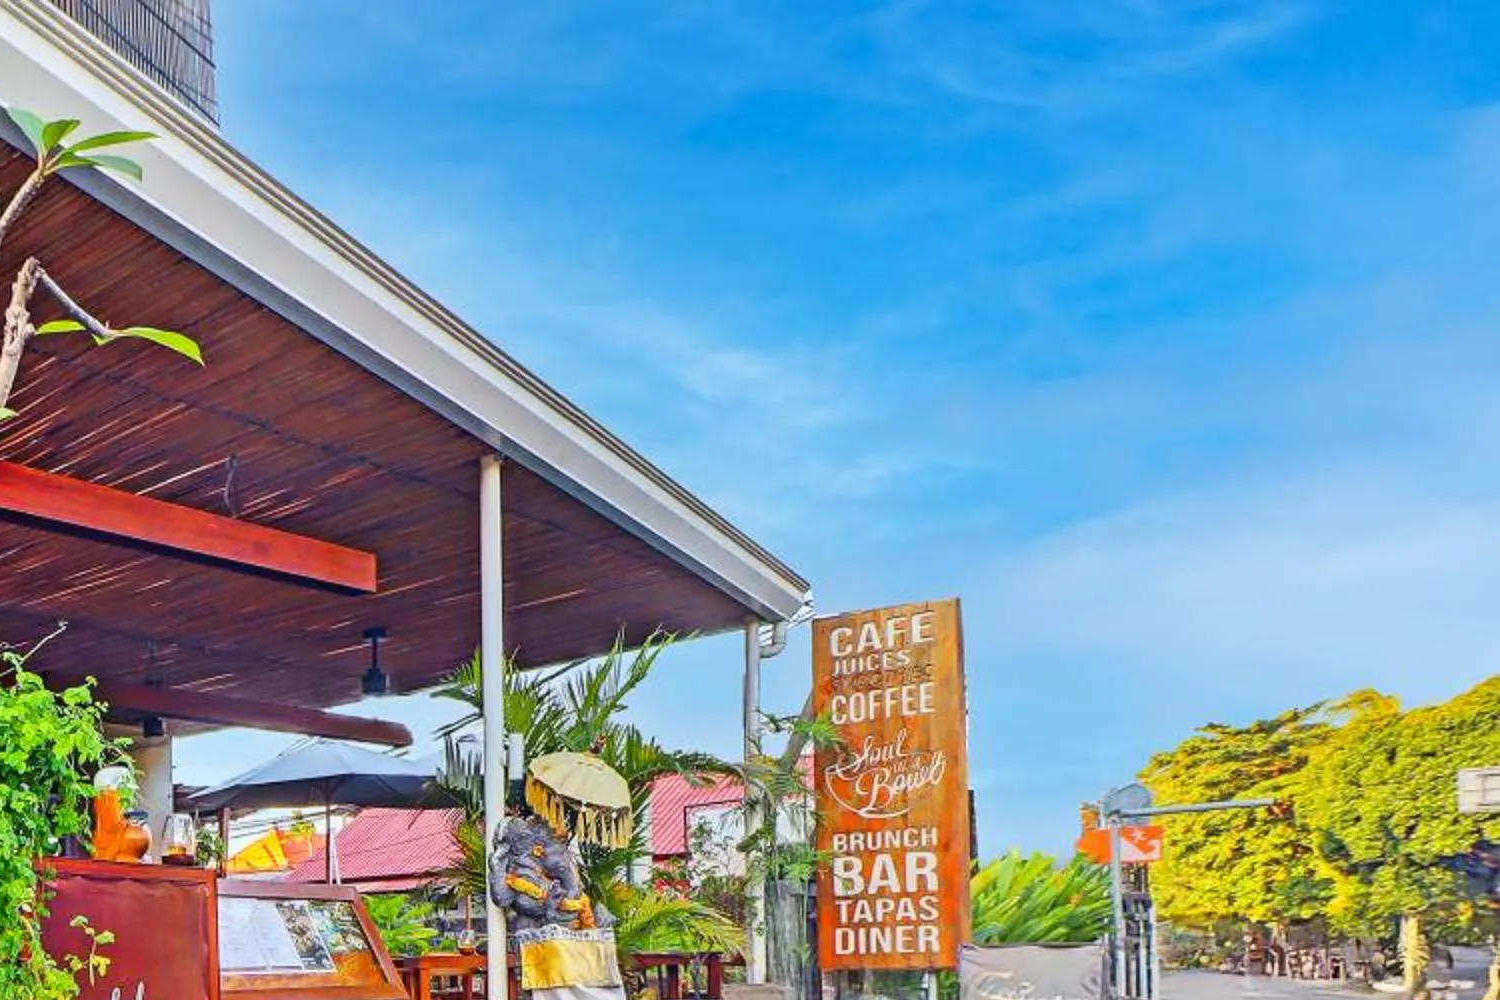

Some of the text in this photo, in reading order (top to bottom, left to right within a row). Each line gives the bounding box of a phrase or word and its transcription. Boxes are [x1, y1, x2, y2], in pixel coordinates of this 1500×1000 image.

[830, 610, 936, 657] CAFE
[833, 650, 911, 677] JUICES
[831, 682, 937, 725] COFFEE
[832, 827, 938, 853] BRUNCH
[833, 851, 940, 897] BAR
[835, 895, 940, 923] TAPAS
[835, 925, 941, 956] DINER
